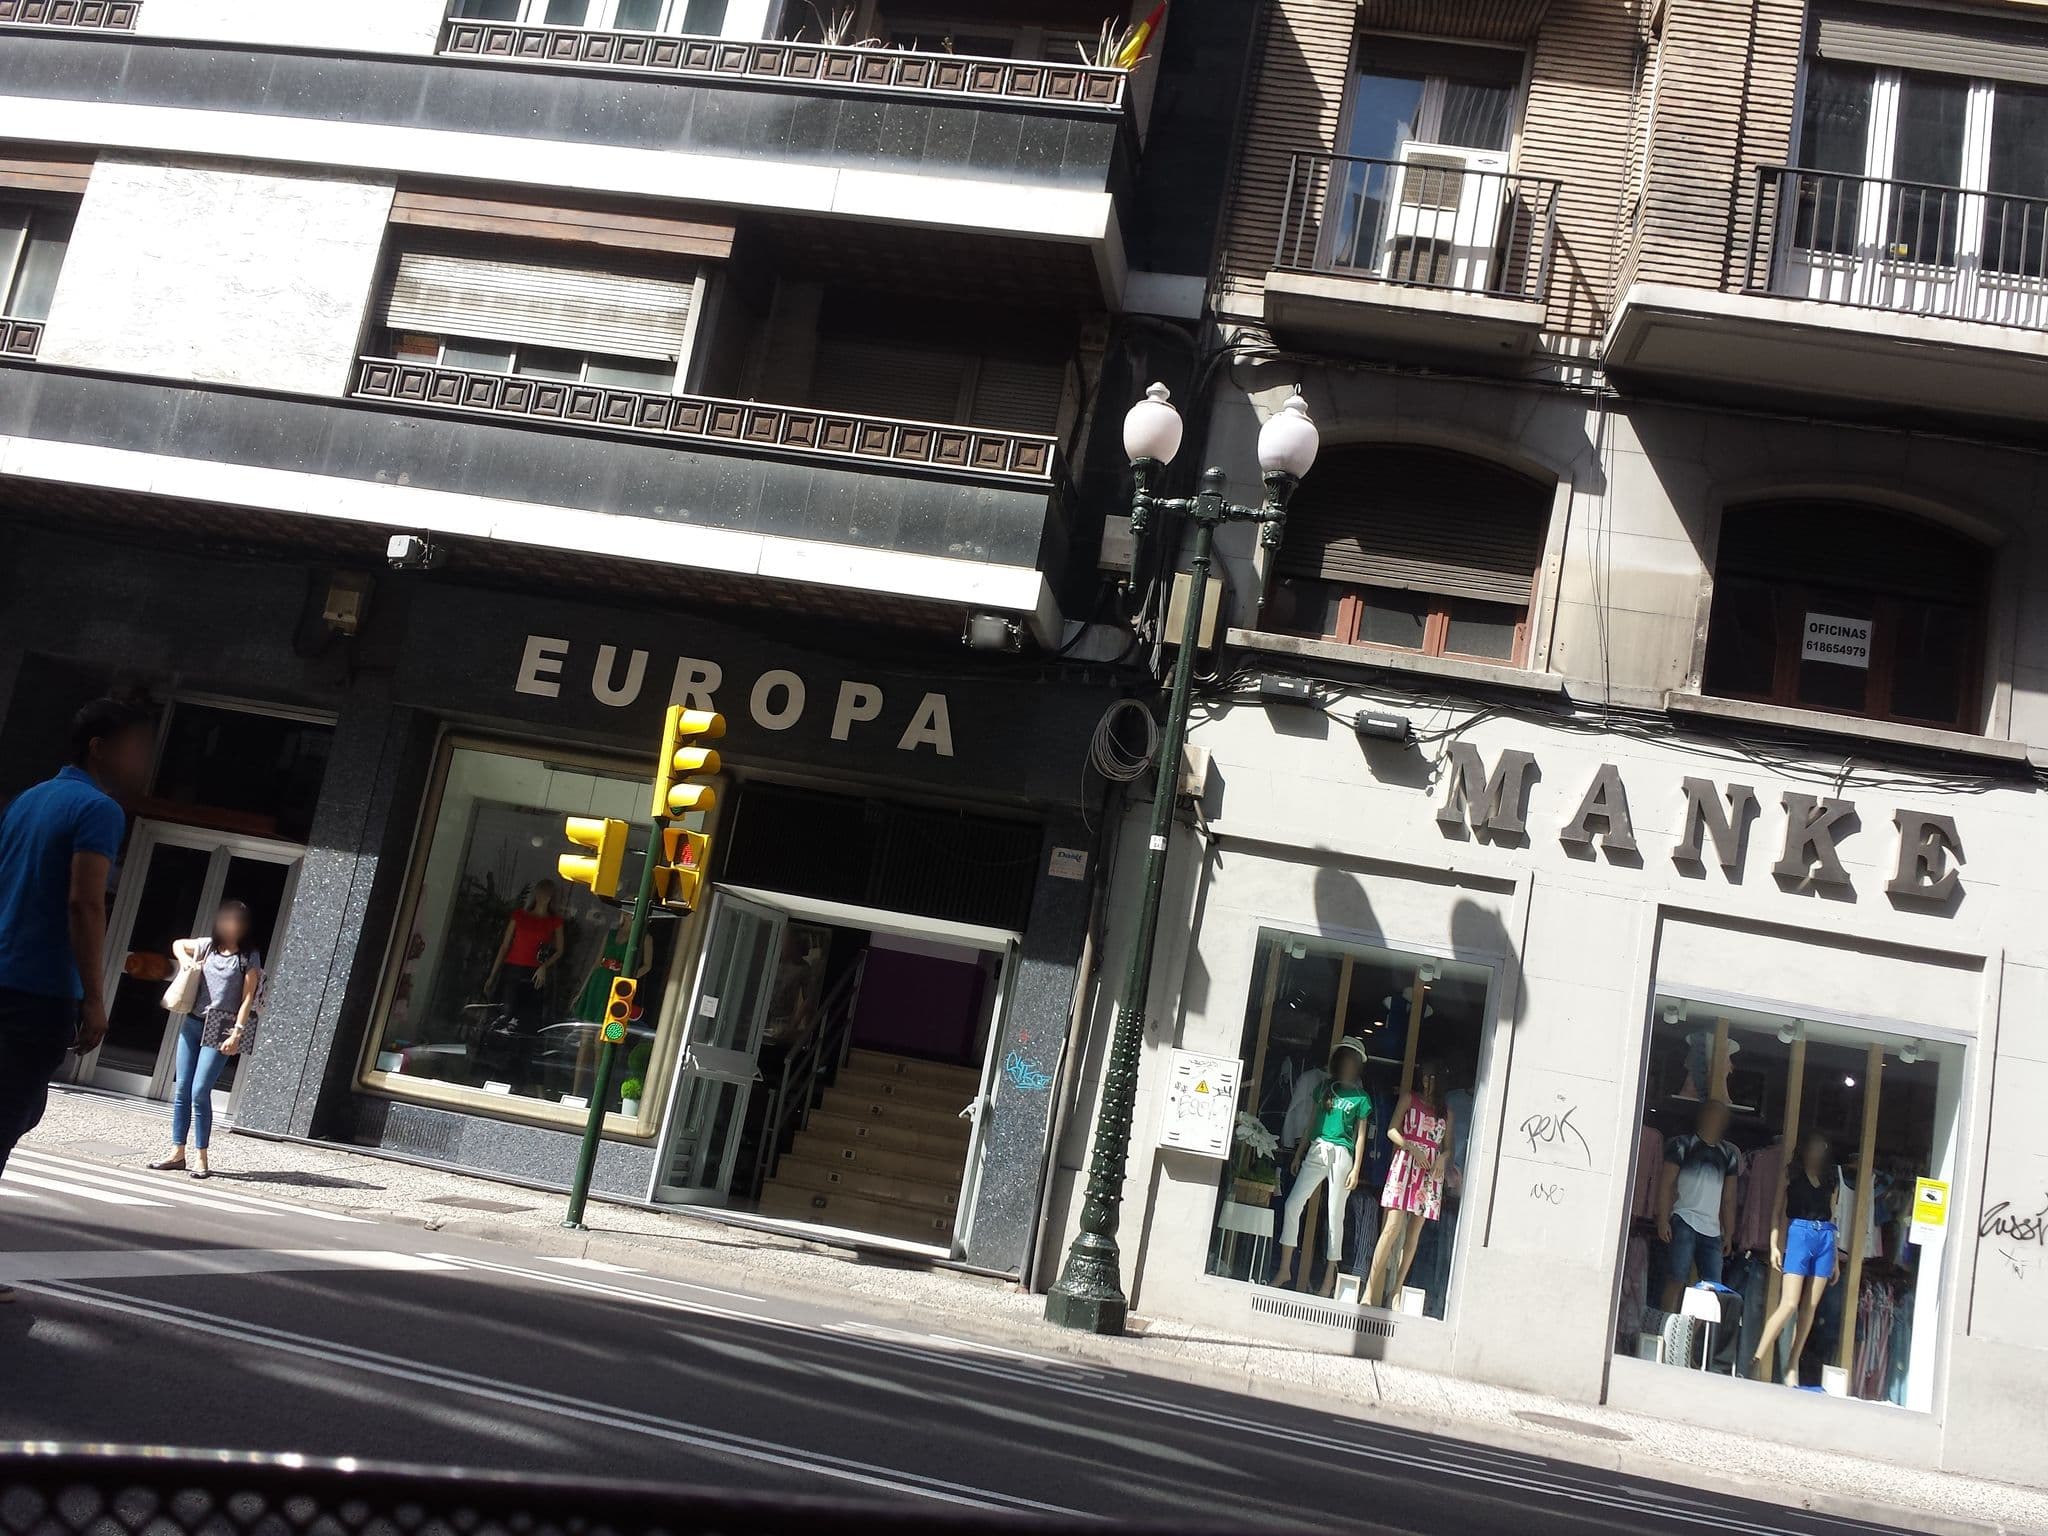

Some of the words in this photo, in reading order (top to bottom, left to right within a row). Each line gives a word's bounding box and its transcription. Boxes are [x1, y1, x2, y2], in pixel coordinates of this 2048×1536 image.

[1806, 640, 1866, 657] 618654979
[1809, 622, 1867, 640] OFICINAS
[514, 634, 955, 757] EUROPA
[1435, 741, 1966, 918] MANKE
